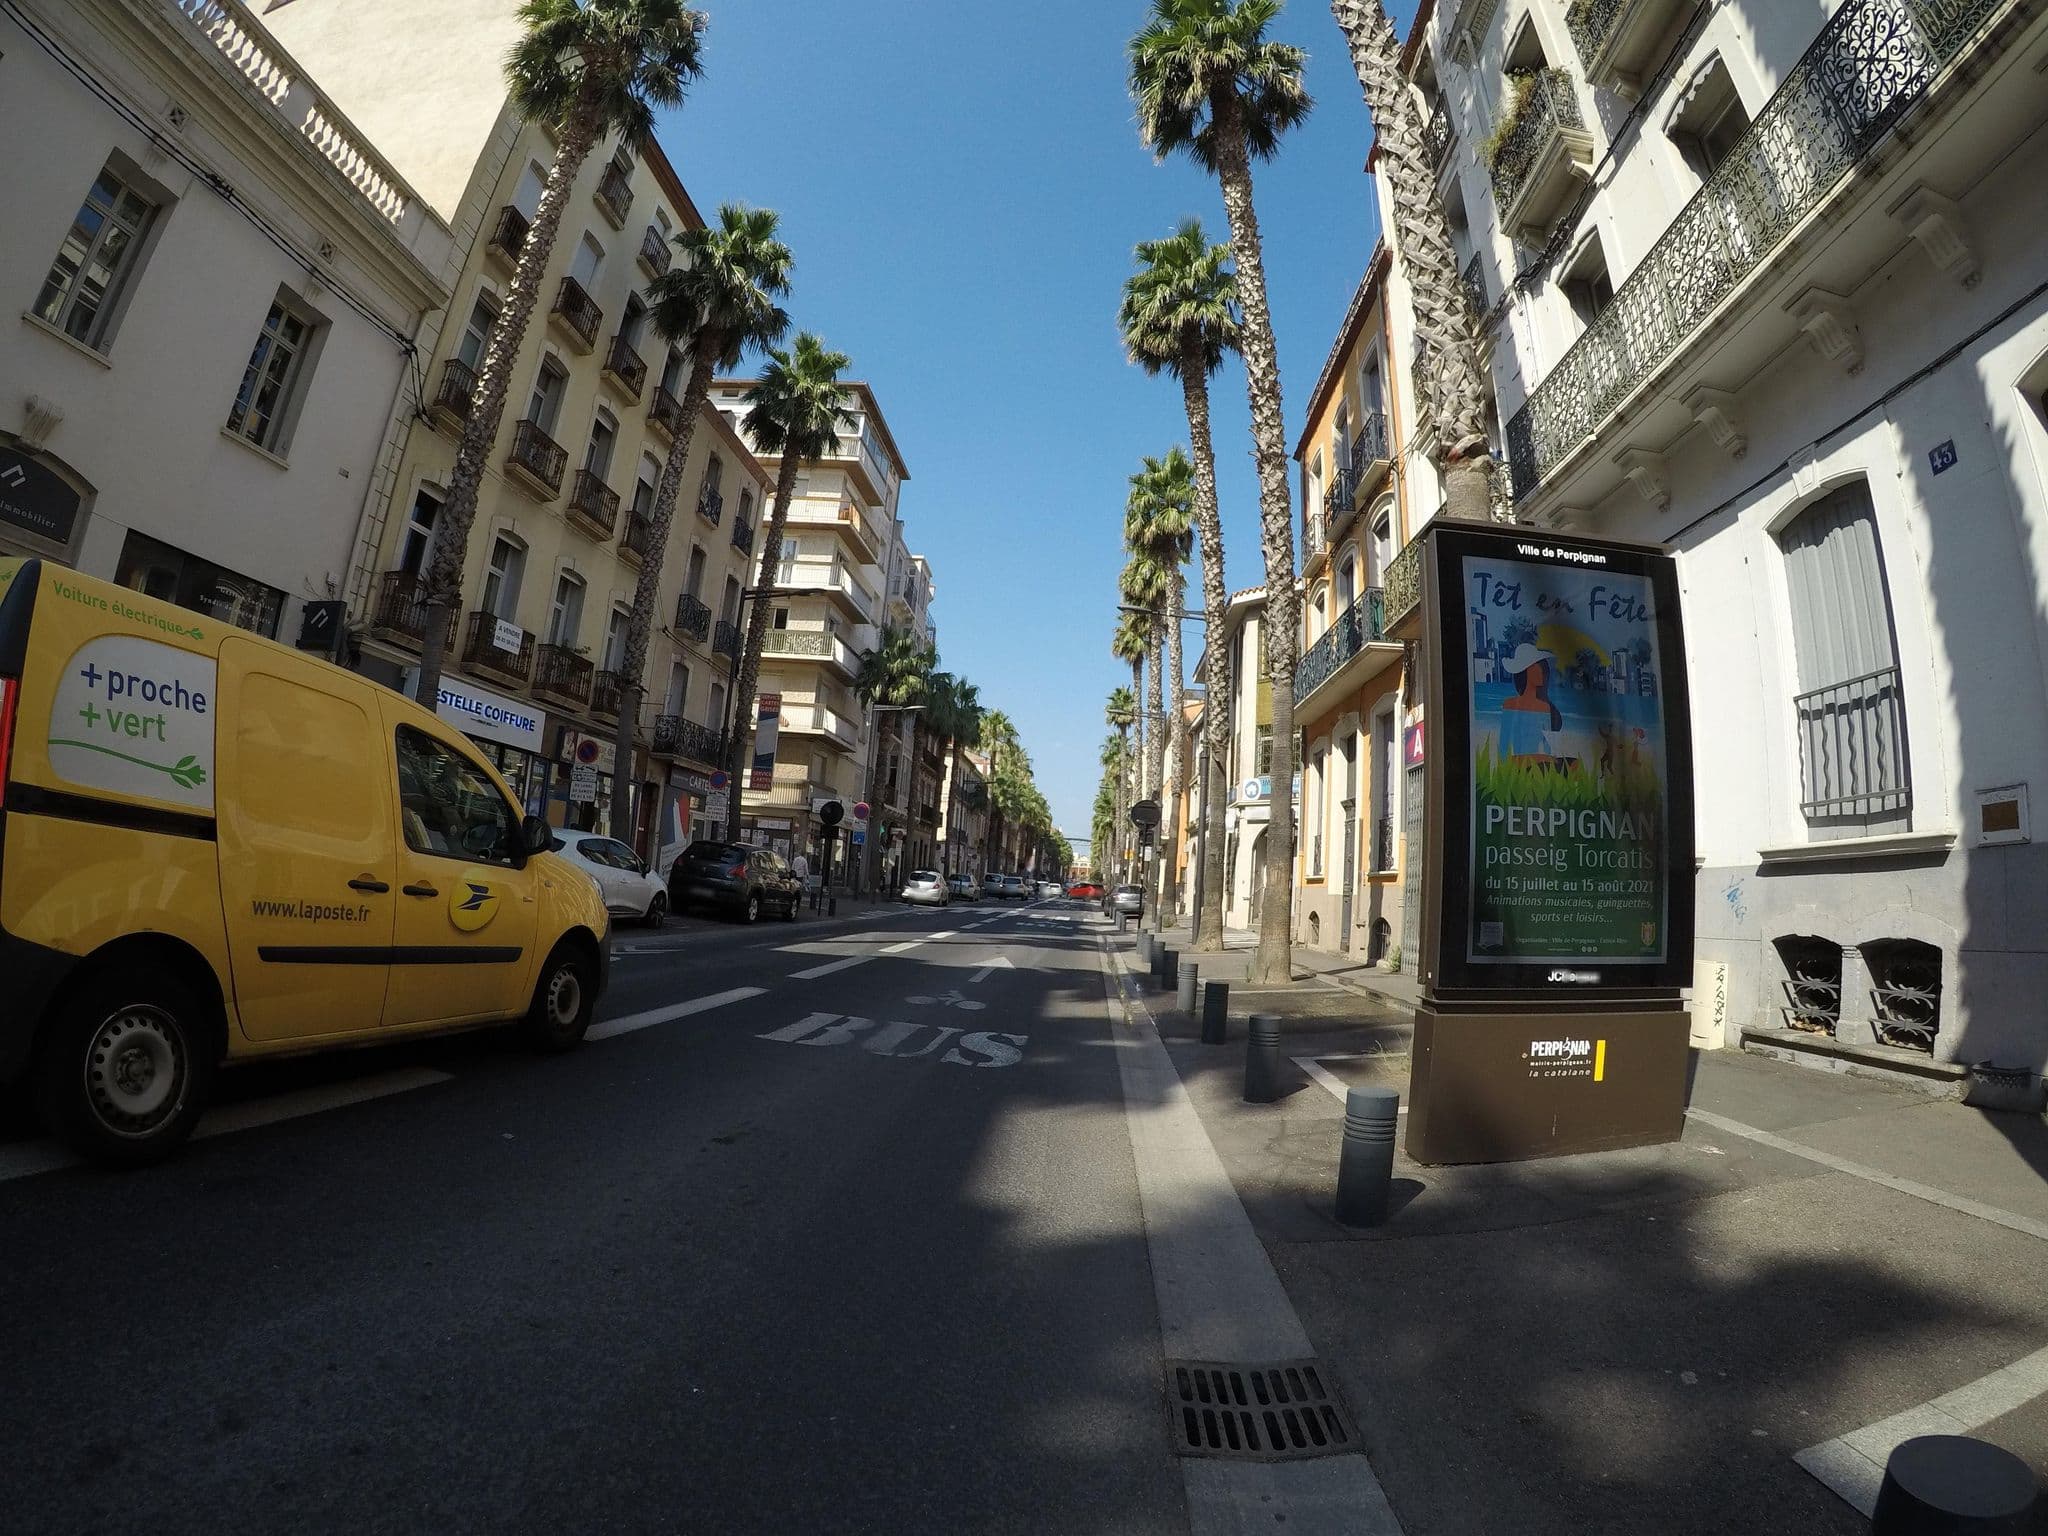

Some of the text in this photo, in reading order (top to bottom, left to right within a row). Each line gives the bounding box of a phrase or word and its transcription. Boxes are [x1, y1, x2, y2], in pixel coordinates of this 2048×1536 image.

[1932, 446, 1953, 469] 43
[1517, 544, 1606, 564] Ville de Perpignan
[53, 580, 185, 635] Voiture électrique
[1473, 572, 1648, 623] Têt en Fête
[437, 688, 482, 715] ESTELLE
[485, 705, 536, 732] COIFFURE
[1485, 805, 1656, 840] PERPIGNAN
[1485, 843, 1655, 872] passeig Torcatis
[1485, 876, 1654, 893] du 15 juillet au 15 août 2021
[252, 900, 371, 923] www.laposte.fr
[1485, 894, 1654, 911] Animations musicales, guinguettes,
[1530, 912, 1561, 924] sports
[1563, 913, 1574, 922] et
[753, 1012, 1029, 1067] BUS
[1544, 1069, 1591, 1077] catalane
